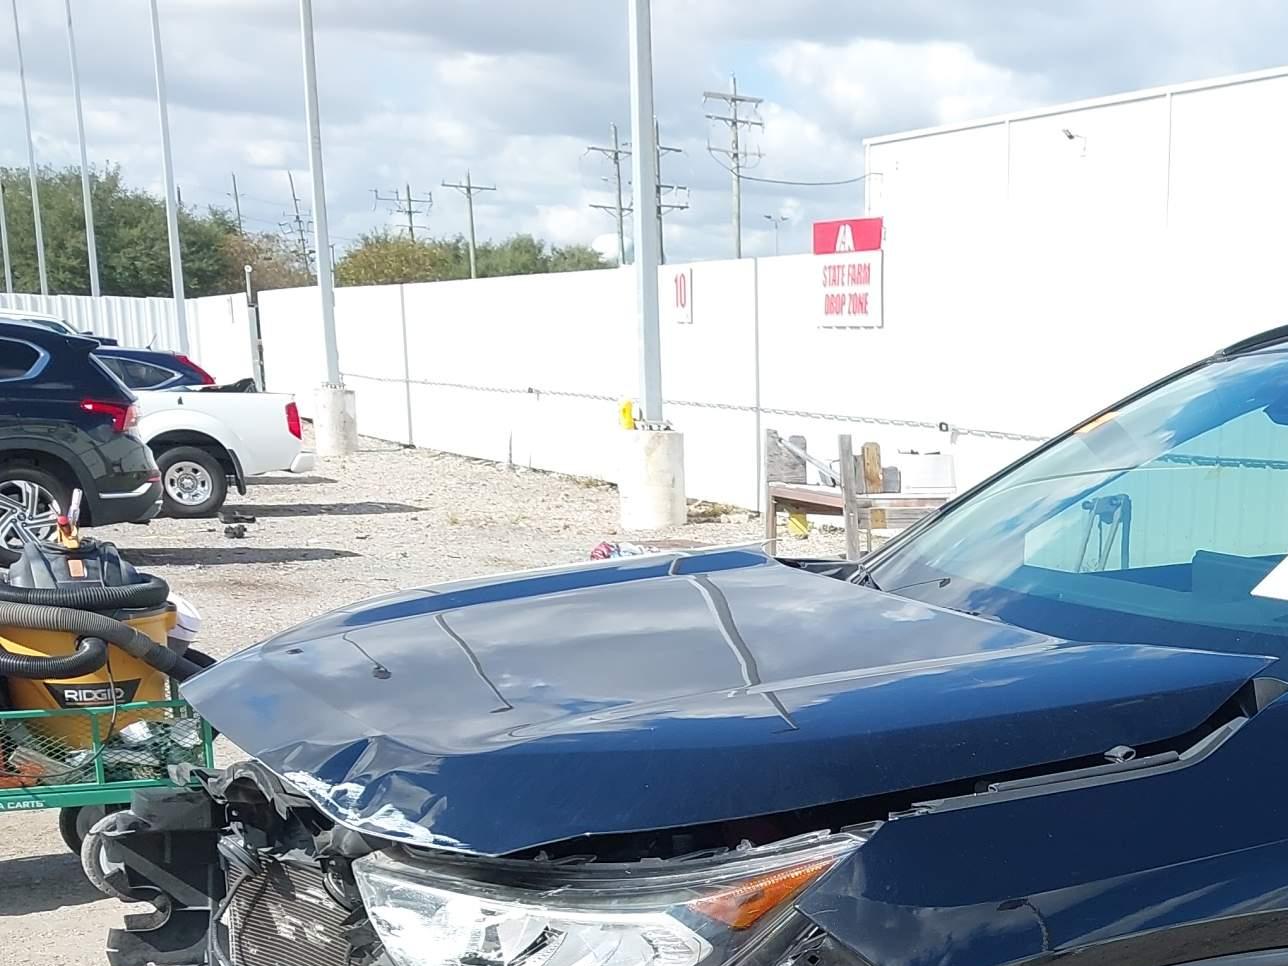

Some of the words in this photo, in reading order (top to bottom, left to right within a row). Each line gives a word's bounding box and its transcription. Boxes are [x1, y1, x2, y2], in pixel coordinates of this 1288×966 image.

[823, 264, 845, 288] STATE
[847, 262, 871, 286] FARM
[674, 272, 687, 309] 10
[824, 293, 846, 315] DROP
[848, 292, 869, 315] ZONE
[64, 687, 125, 702] RIDGID
[7, 800, 44, 809] CARTS
